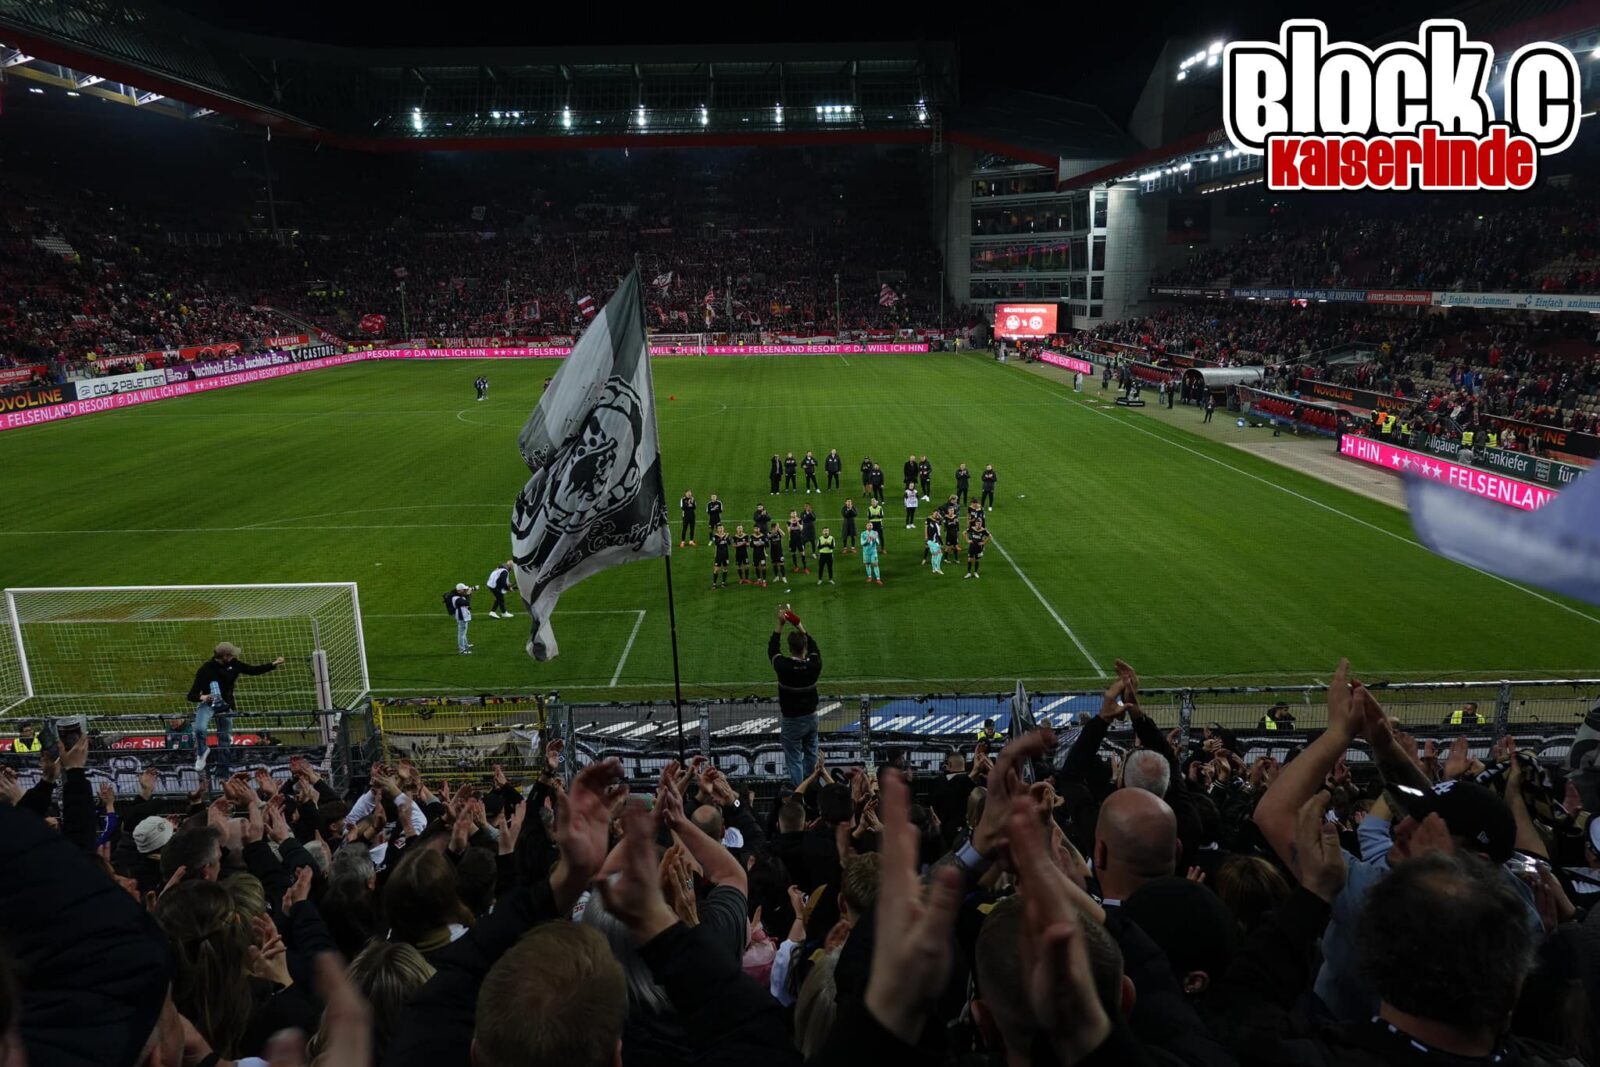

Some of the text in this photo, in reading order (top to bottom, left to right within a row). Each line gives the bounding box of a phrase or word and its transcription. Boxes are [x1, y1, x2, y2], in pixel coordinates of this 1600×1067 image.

[302, 345, 335, 360] CASTORE
[451, 349, 468, 357] ICH
[650, 346, 670, 354] WILL
[748, 345, 805, 353] FELSENLAND
[807, 345, 840, 353] RESORT
[908, 344, 927, 352] HIN.
[7, 404, 76, 426] FELSENLAND
[79, 397, 113, 413] RESORT
[127, 394, 141, 404] DA
[141, 390, 160, 401] WILL
[161, 387, 174, 397] ICH
[1425, 434, 1460, 454] Allgäuer
[1358, 442, 1383, 463] HIN.
